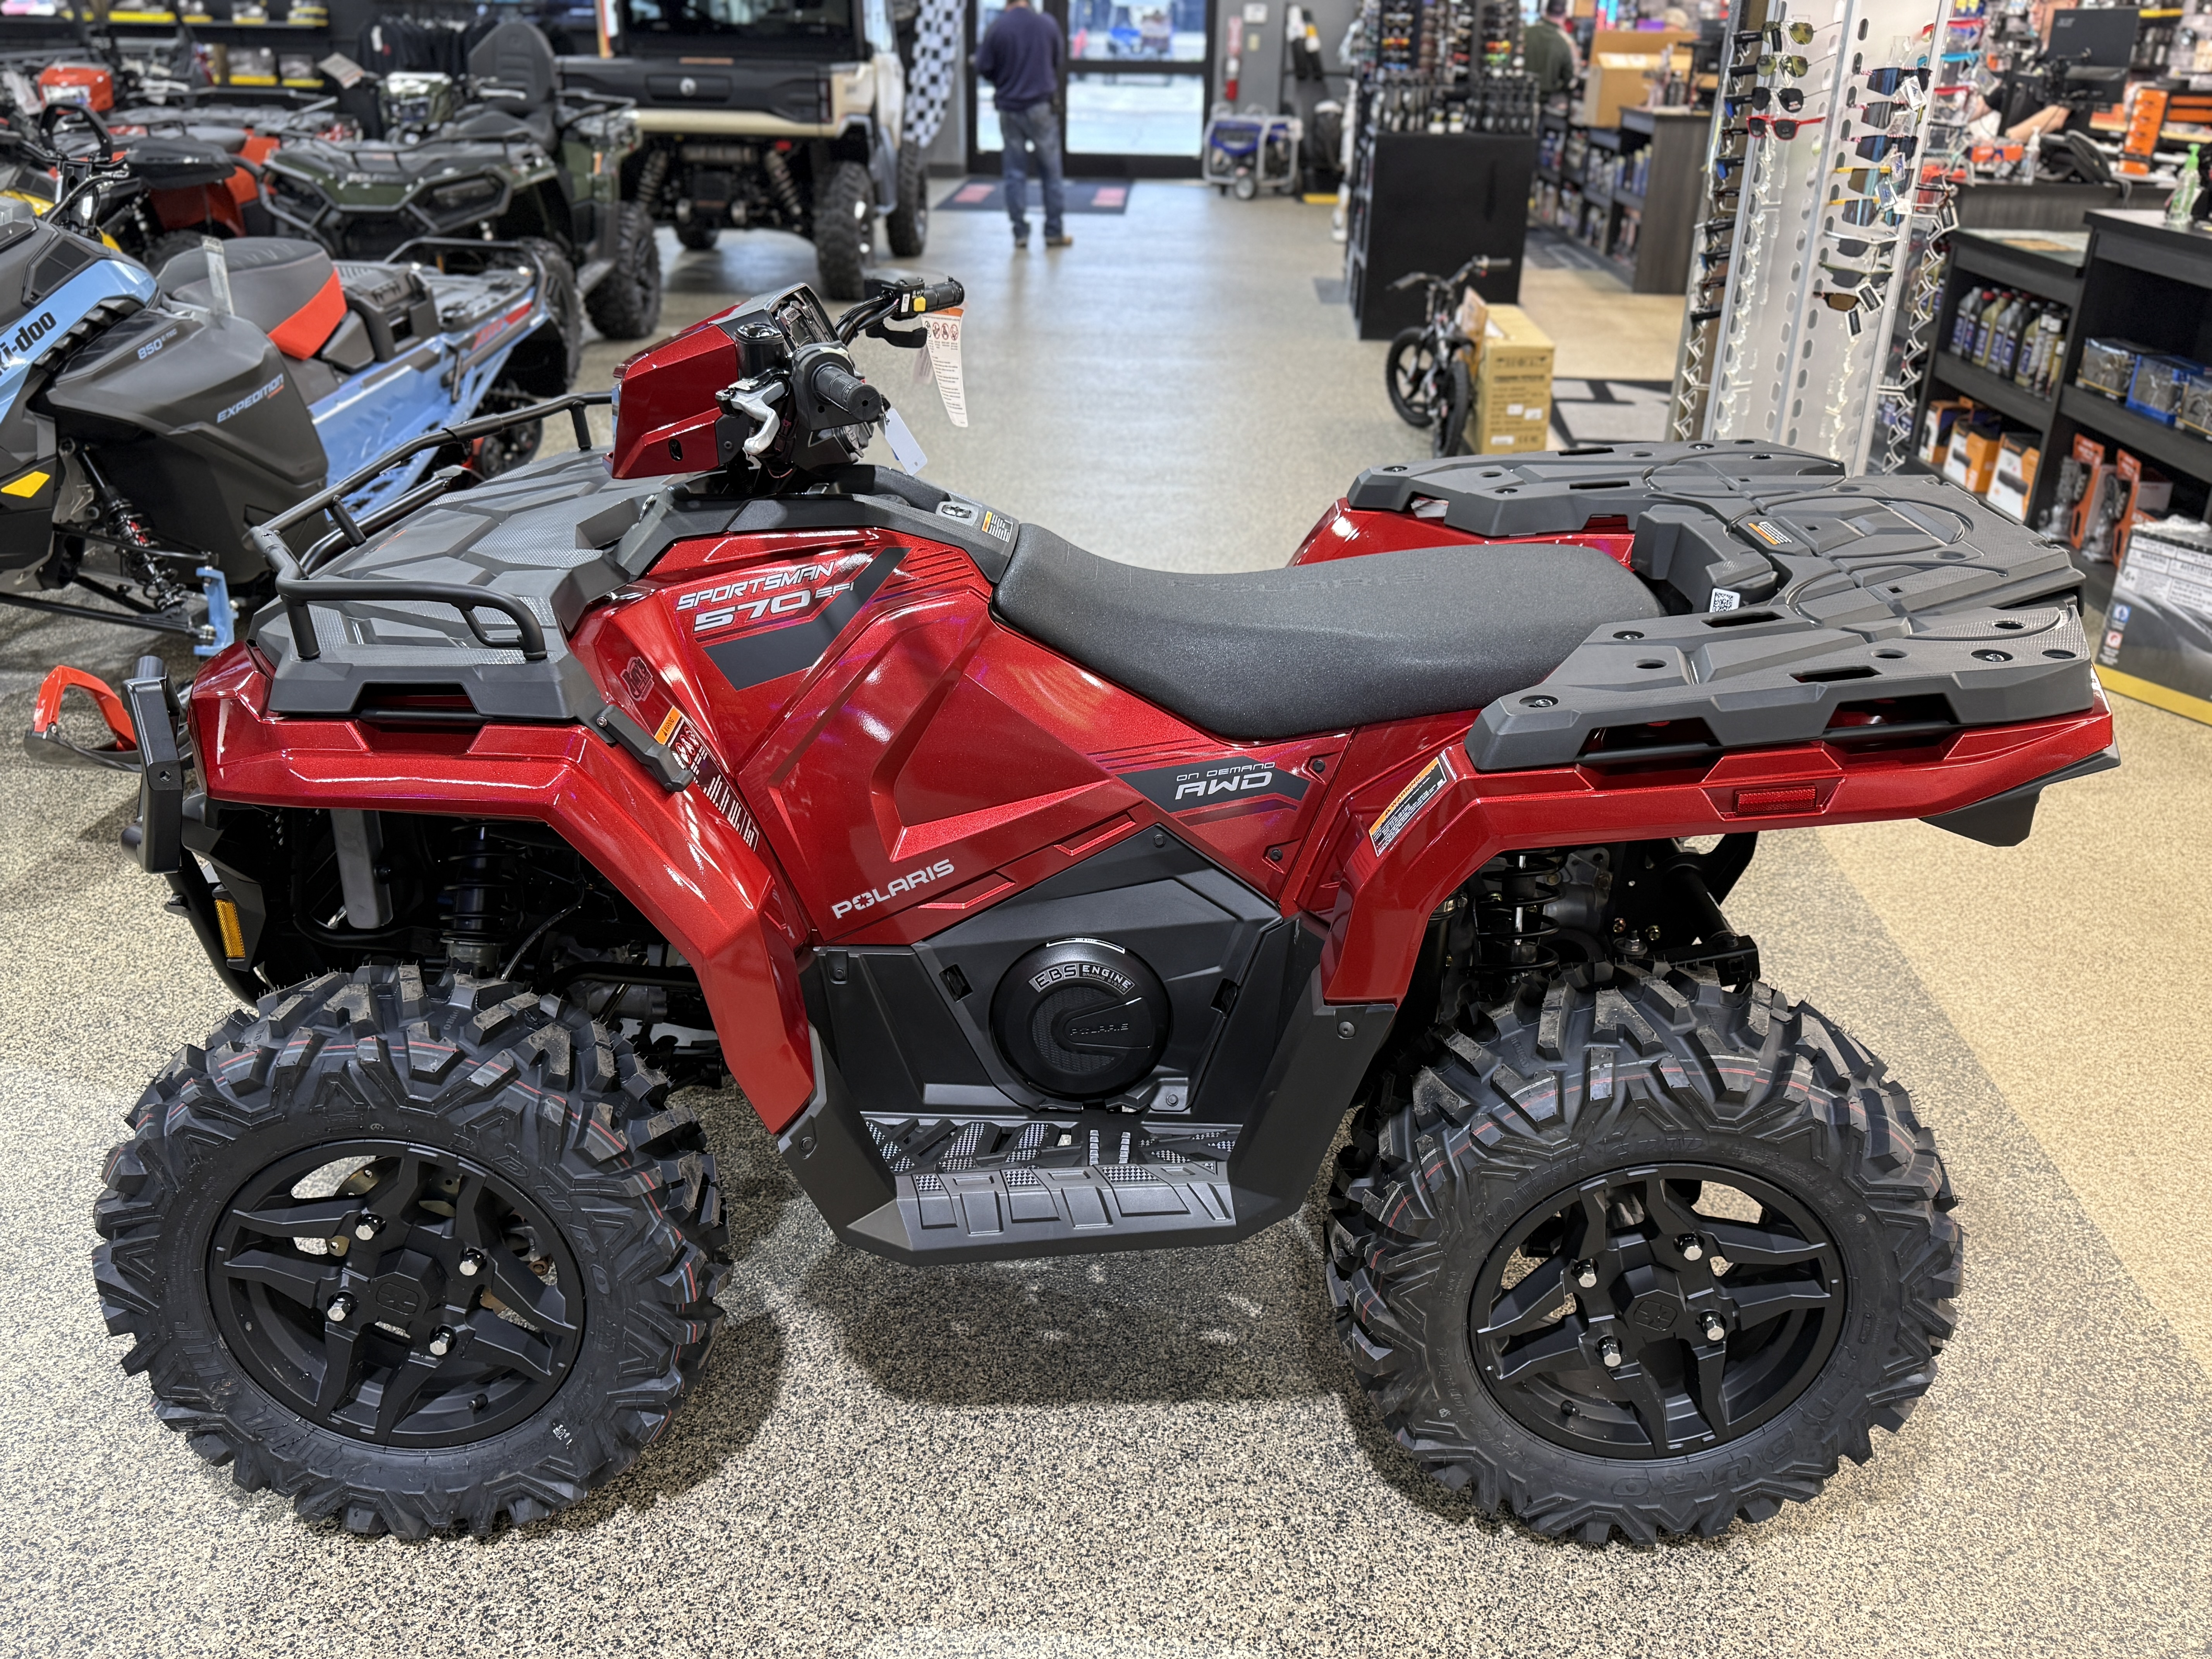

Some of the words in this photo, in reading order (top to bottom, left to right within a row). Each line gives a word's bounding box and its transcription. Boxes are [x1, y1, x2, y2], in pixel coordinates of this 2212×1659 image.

[137, 338, 163, 360] 850
[217, 373, 283, 424] EXPEDITION
[676, 563, 835, 611] SPORTSMAN
[694, 590, 811, 632] 570
[815, 582, 854, 599] EFI
[1175, 771, 1273, 800] AWD
[1176, 773, 1199, 781] ON
[1206, 762, 1276, 776] DEMAND
[1391, 776, 1421, 809] WARNING
[831, 858, 955, 919] POLARIS
[1035, 964, 1077, 988] EBS
[1082, 965, 1131, 988] ENGINE
[1107, 978, 1126, 992] SYSTEM
